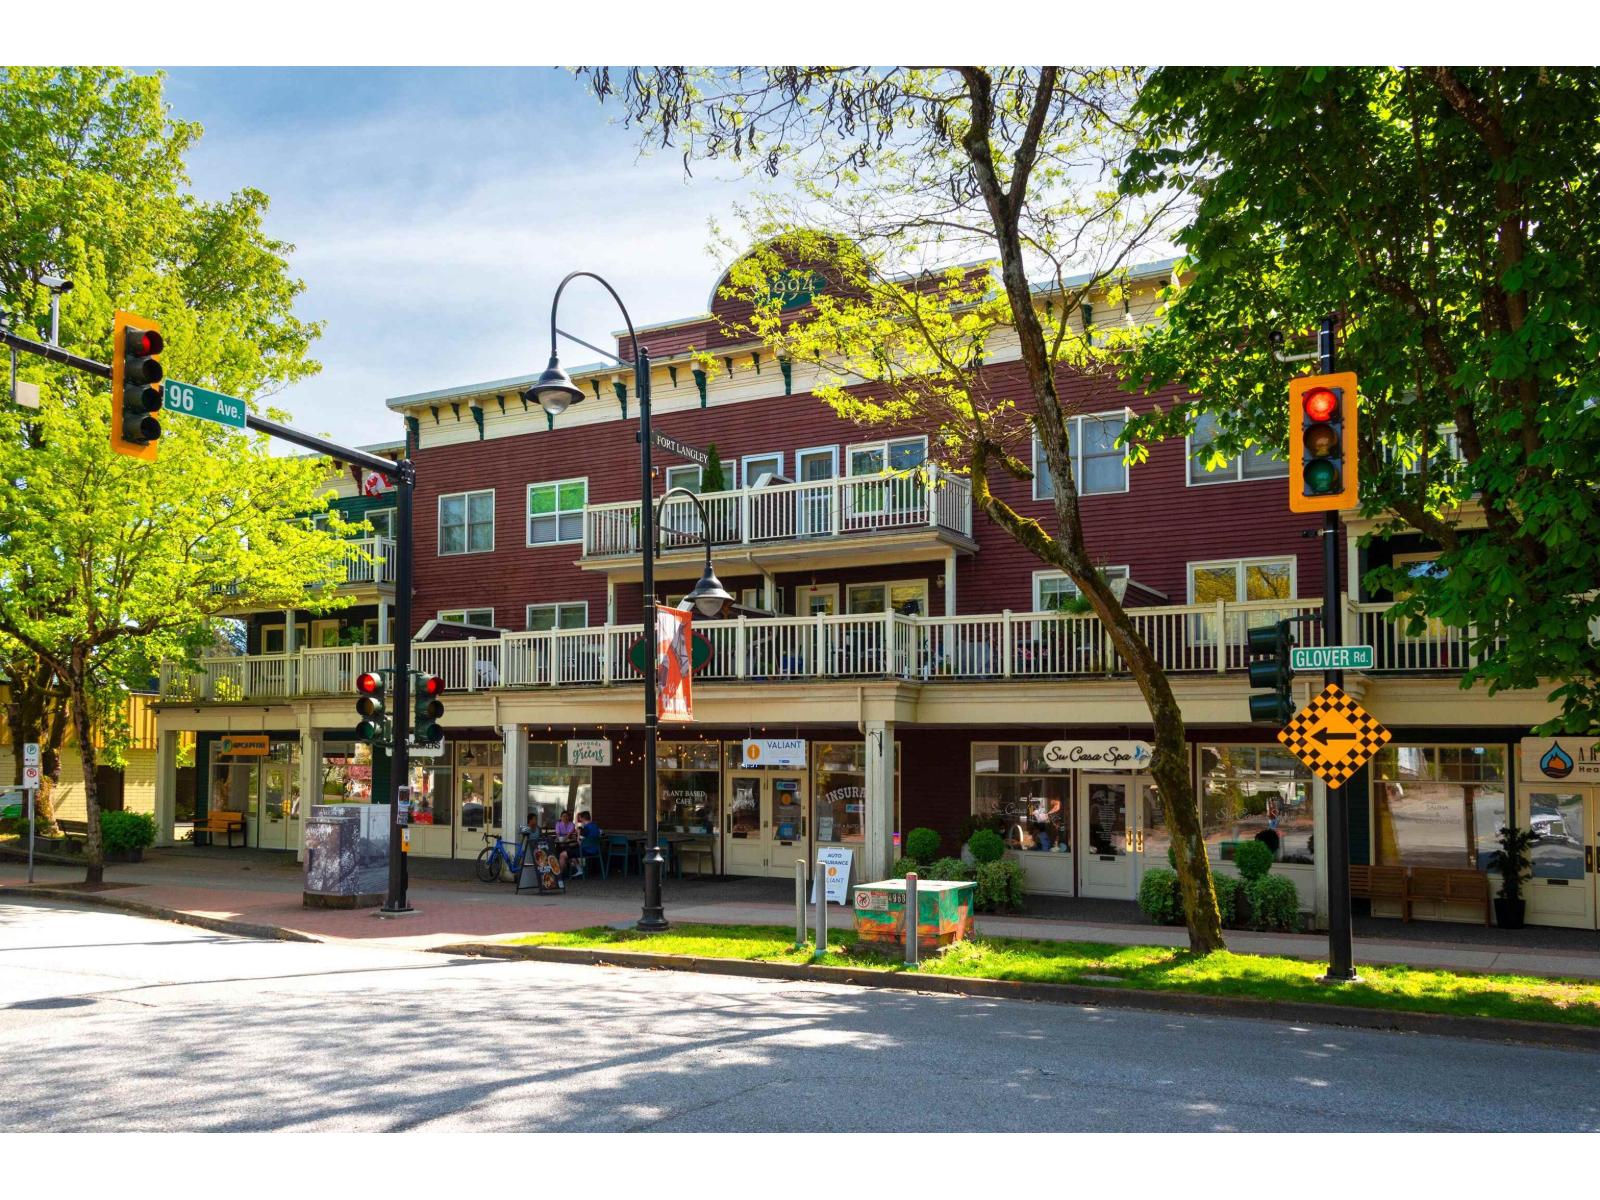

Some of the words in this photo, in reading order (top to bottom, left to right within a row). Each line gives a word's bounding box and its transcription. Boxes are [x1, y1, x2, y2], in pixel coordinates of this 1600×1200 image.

[170, 385, 194, 411] 96
[216, 400, 241, 419] Ave.
[656, 435, 676, 451] FORT
[676, 444, 708, 464] LANGLEY
[1296, 650, 1350, 667] GLOVER
[1353, 651, 1369, 663] Rd.
[767, 741, 801, 750] VALIANT
[572, 748, 604, 764] greens
[1046, 746, 1069, 762] Su
[1069, 746, 1102, 762] Casa
[1103, 746, 1132, 766] Spa
[663, 790, 684, 798] PLANT
[684, 790, 706, 798] BASED
